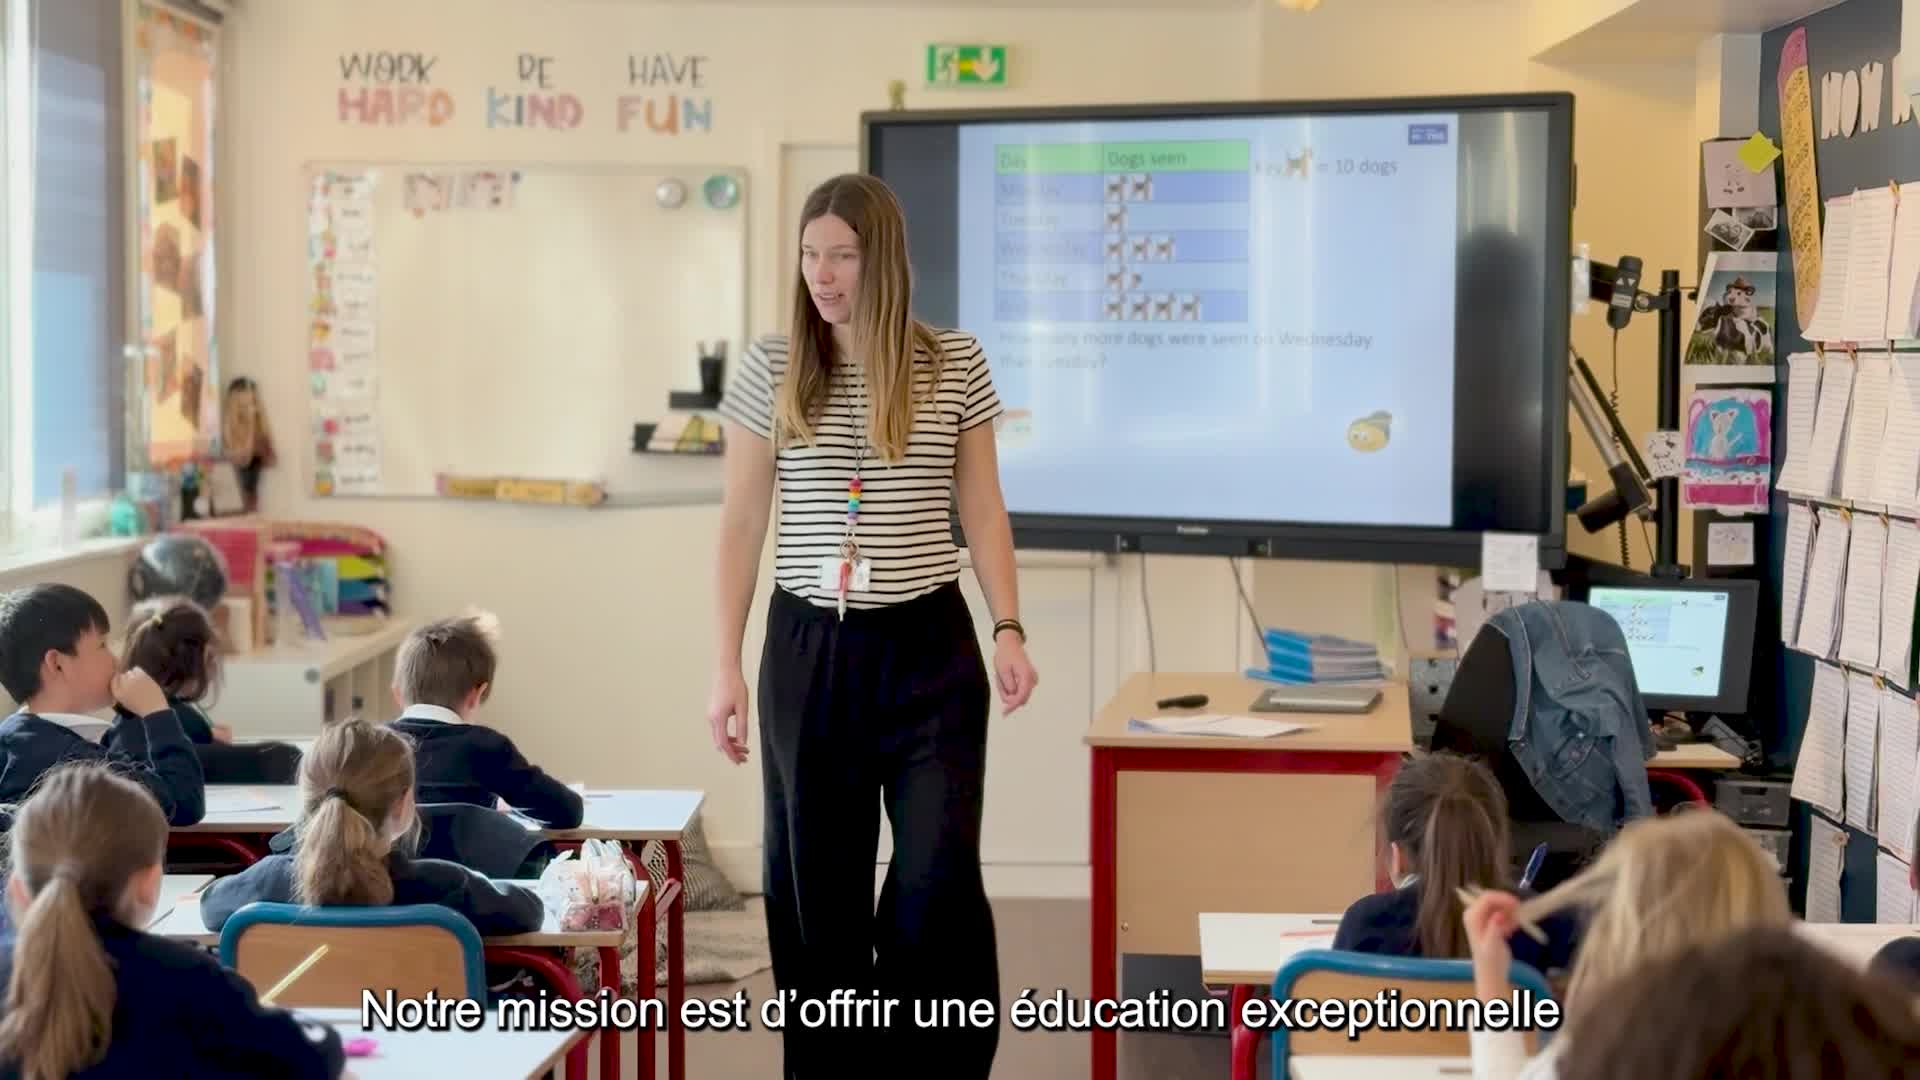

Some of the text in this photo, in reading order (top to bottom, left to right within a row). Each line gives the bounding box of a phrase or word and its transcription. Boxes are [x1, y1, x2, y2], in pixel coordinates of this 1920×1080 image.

[628, 54, 709, 87] HAVE
[486, 87, 584, 129] KIND
[617, 95, 712, 134] FUN
[1107, 151, 1187, 169] Dogs seen
[1335, 158, 1354, 175] 10
[1359, 157, 1399, 177] dogs
[1083, 333, 1123, 345] more
[1127, 330, 1163, 349] dogs
[1168, 334, 1206, 345] were
[1212, 334, 1248, 345] seen
[1278, 330, 1374, 350] Wednesday
